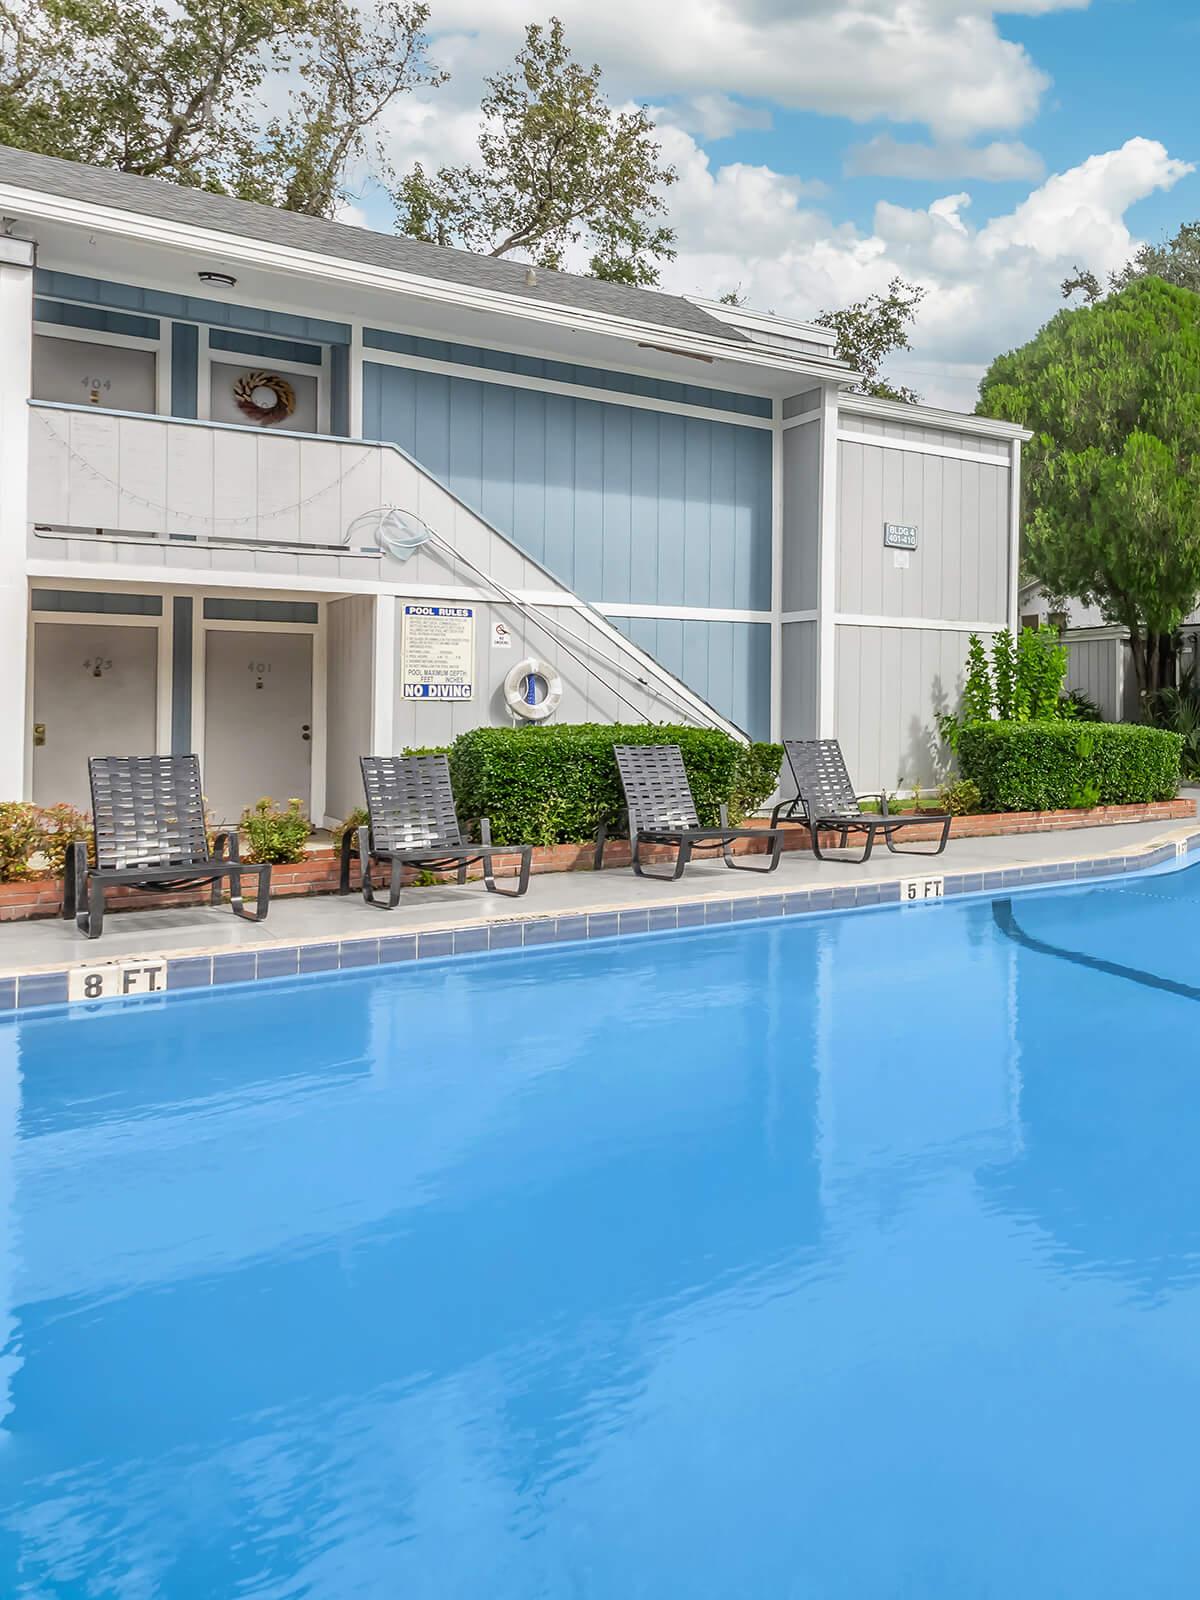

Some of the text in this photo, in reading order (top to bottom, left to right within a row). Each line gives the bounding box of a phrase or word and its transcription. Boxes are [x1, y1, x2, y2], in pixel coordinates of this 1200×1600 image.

[889, 526, 908, 536] BLDG
[409, 606, 468, 617] POOL RULES
[405, 684, 471, 698] NO DIVING
[908, 880, 942, 899] 5 FT.
[84, 966, 162, 998] 8 FT.
